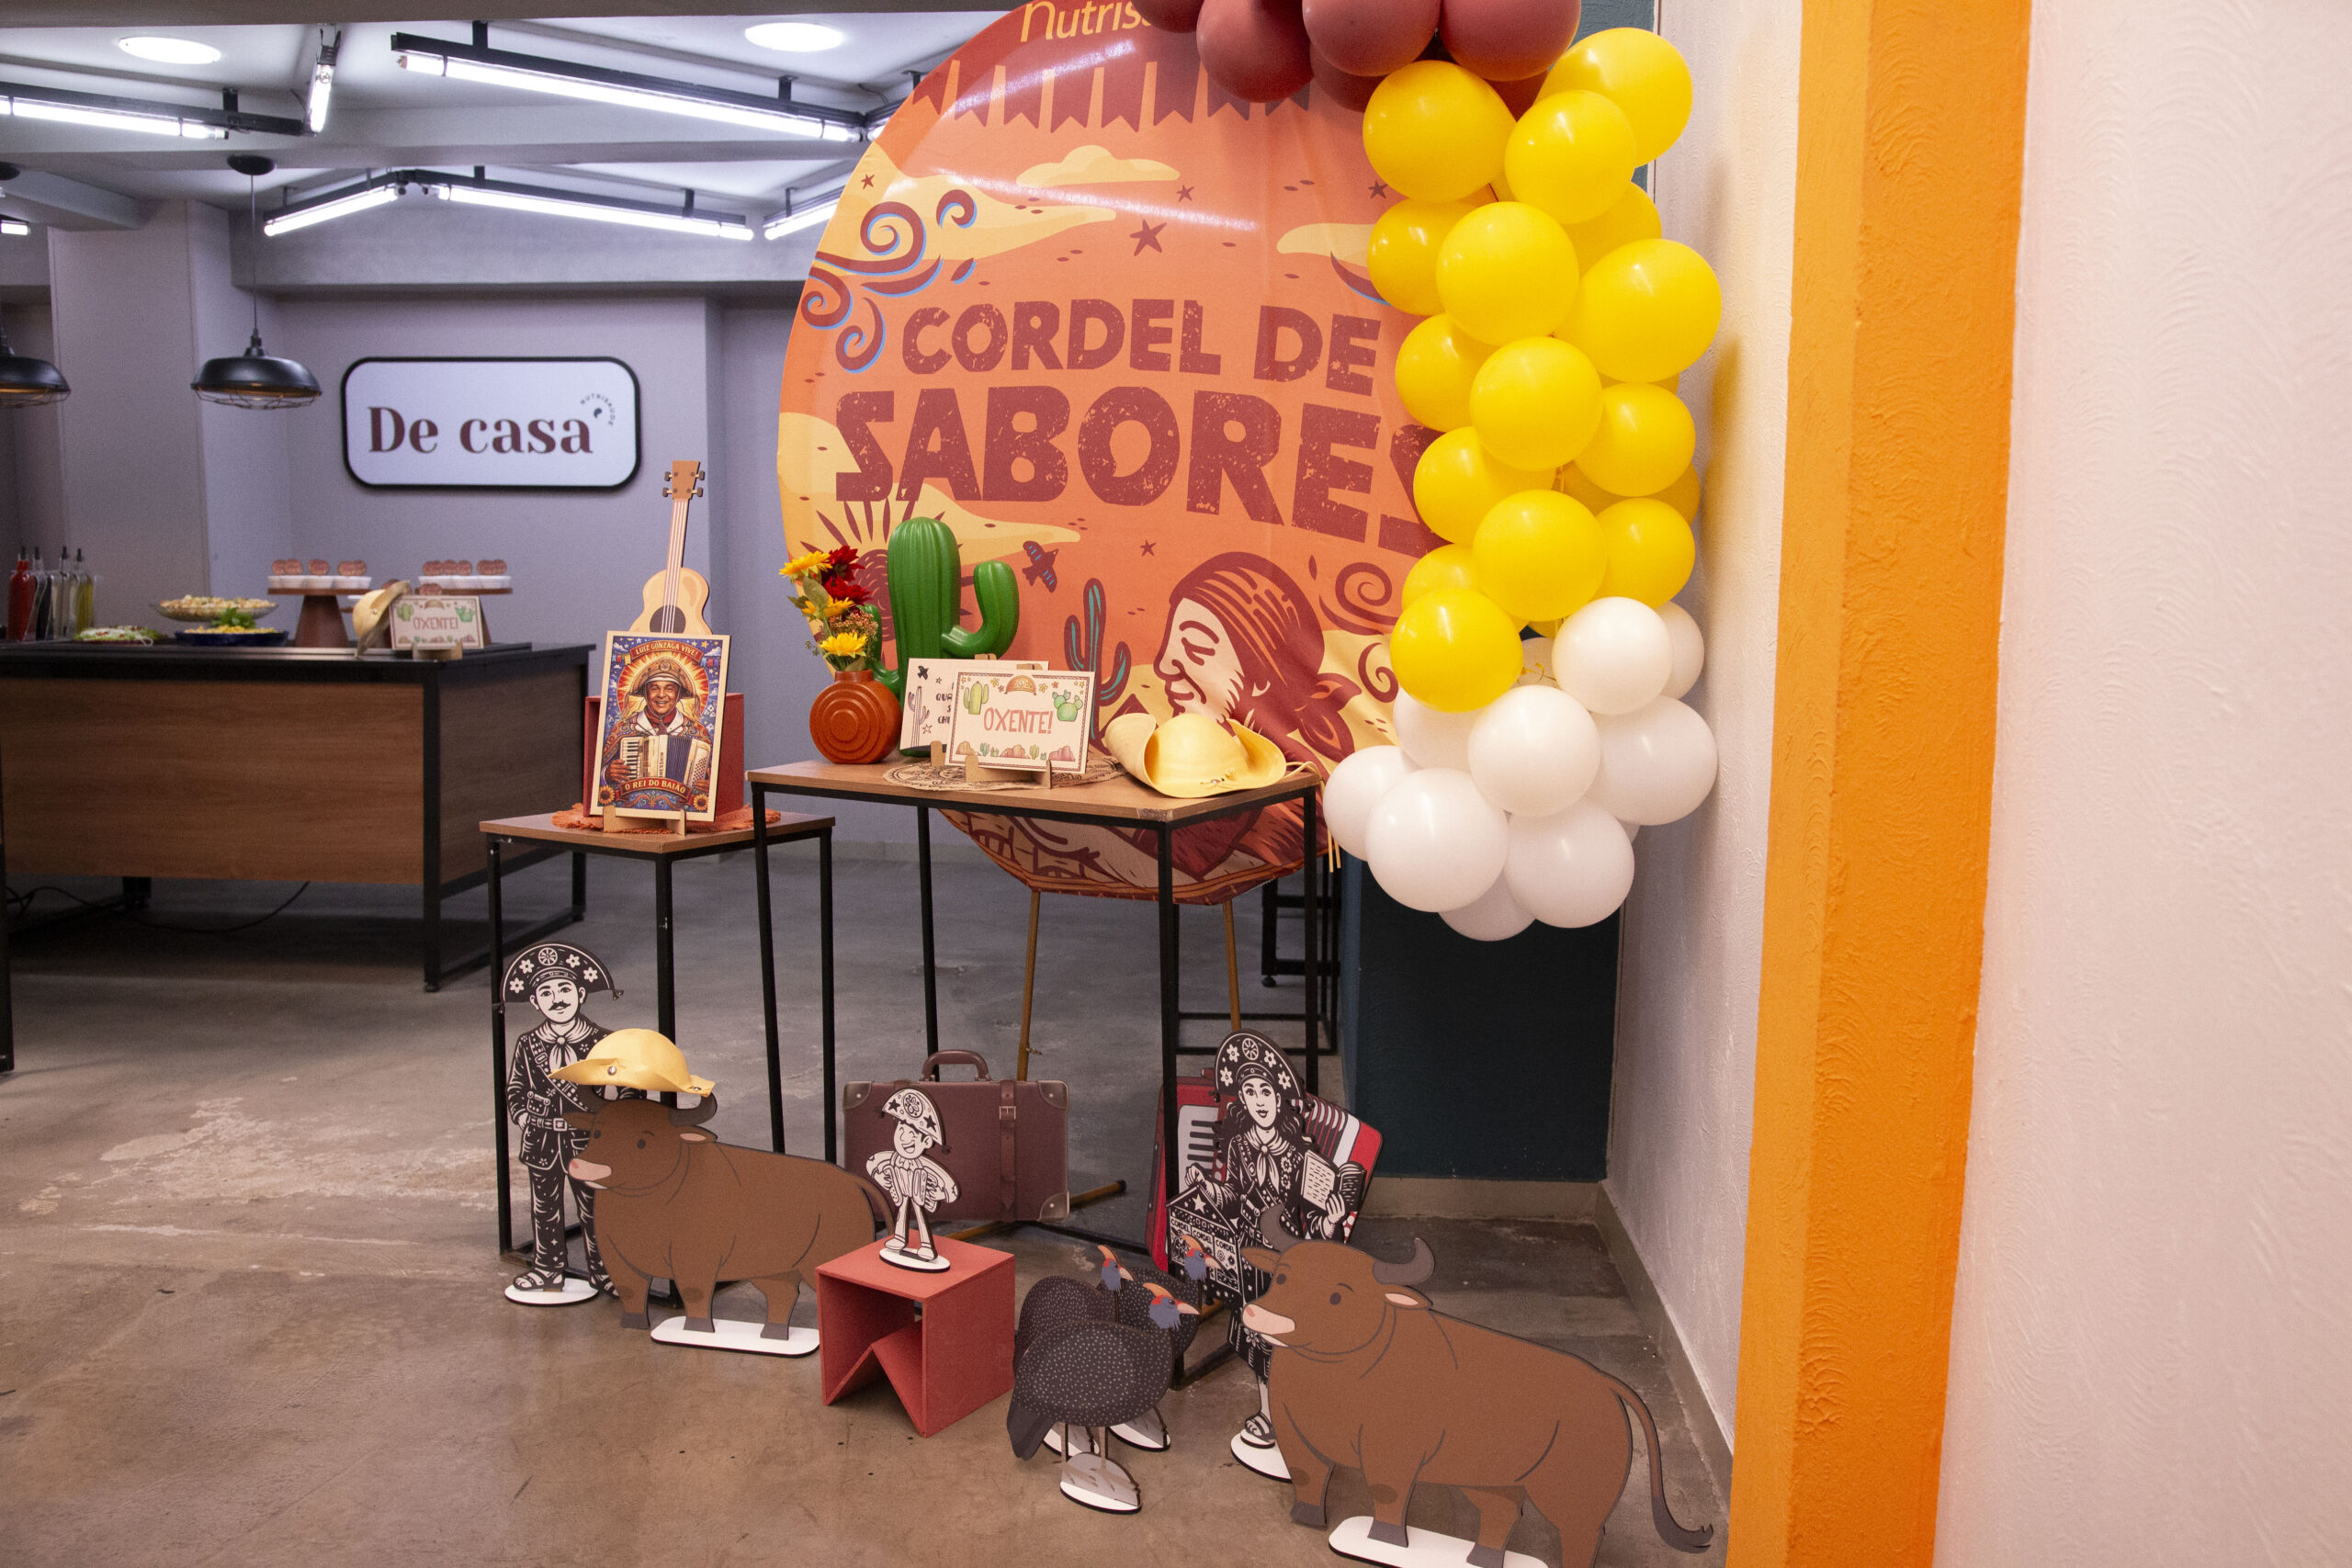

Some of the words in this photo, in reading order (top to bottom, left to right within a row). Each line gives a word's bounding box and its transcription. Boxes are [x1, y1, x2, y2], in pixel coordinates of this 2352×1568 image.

[1021, 0, 1151, 42] Nutris
[902, 299, 1221, 375] CORDEL
[1253, 305, 1381, 396] DE
[368, 407, 438, 454] De
[459, 419, 593, 454] casa
[635, 645, 650, 655] LUIZ
[651, 642, 680, 650] GONZAGA
[681, 645, 699, 656] VIVE!
[984, 707, 1054, 734] OXENTE!
[632, 780, 647, 789] REI
